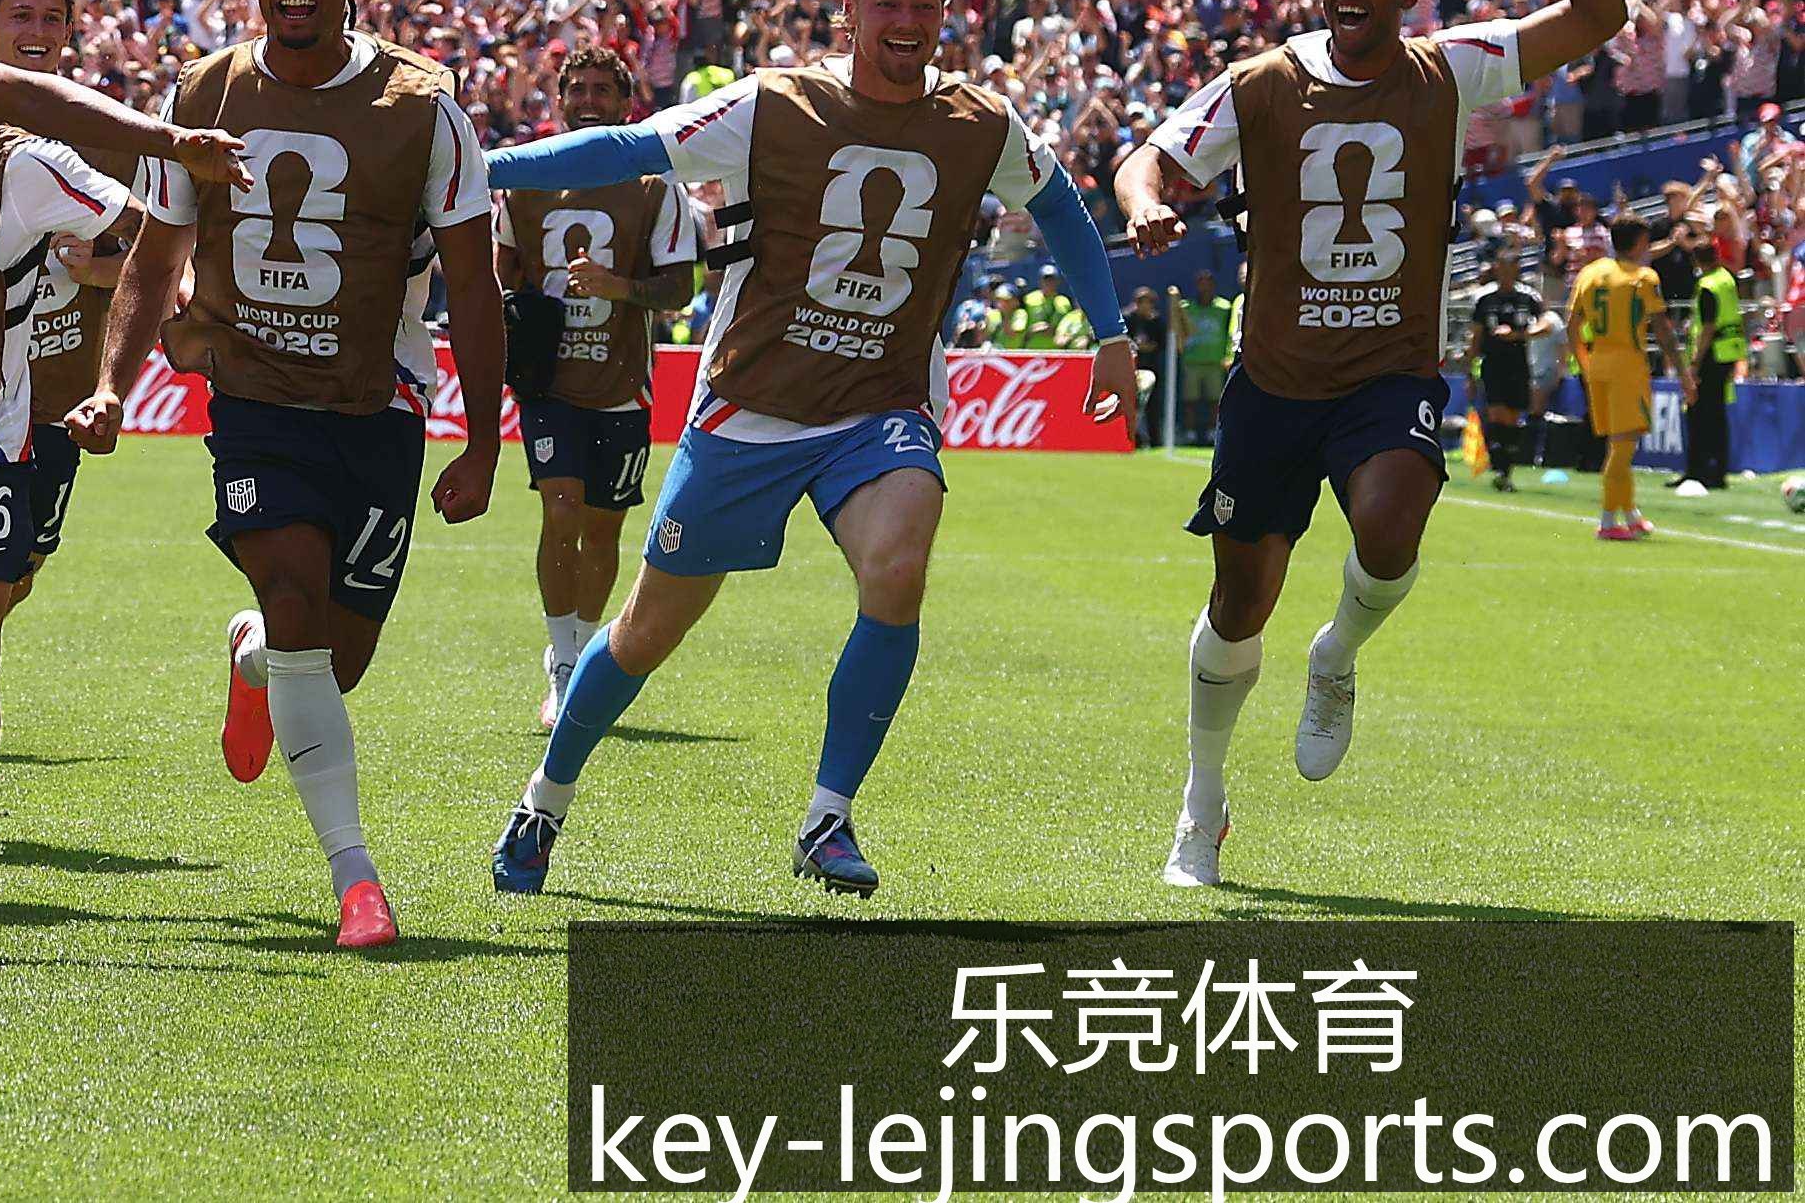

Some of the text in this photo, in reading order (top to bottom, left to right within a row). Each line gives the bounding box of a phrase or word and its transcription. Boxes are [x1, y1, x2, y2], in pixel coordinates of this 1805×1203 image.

[1330, 251, 1378, 268] FIFA
[36, 282, 56, 300] FA
[259, 268, 310, 291] FIFA
[835, 277, 882, 302] FIFA
[1301, 286, 1402, 302] WORLD CUP
[52, 310, 82, 331] CUP
[235, 302, 340, 329] WORLD CUP
[794, 305, 896, 337] WORLD CUP
[1298, 303, 1402, 328] 2026
[27, 327, 83, 361] 026
[584, 331, 611, 342] CUP
[782, 323, 885, 360] 2026
[556, 342, 609, 363] 026
[1418, 399, 1435, 432] 6
[616, 447, 646, 490] 10
[229, 479, 253, 495] USA
[345, 507, 407, 578] 12
